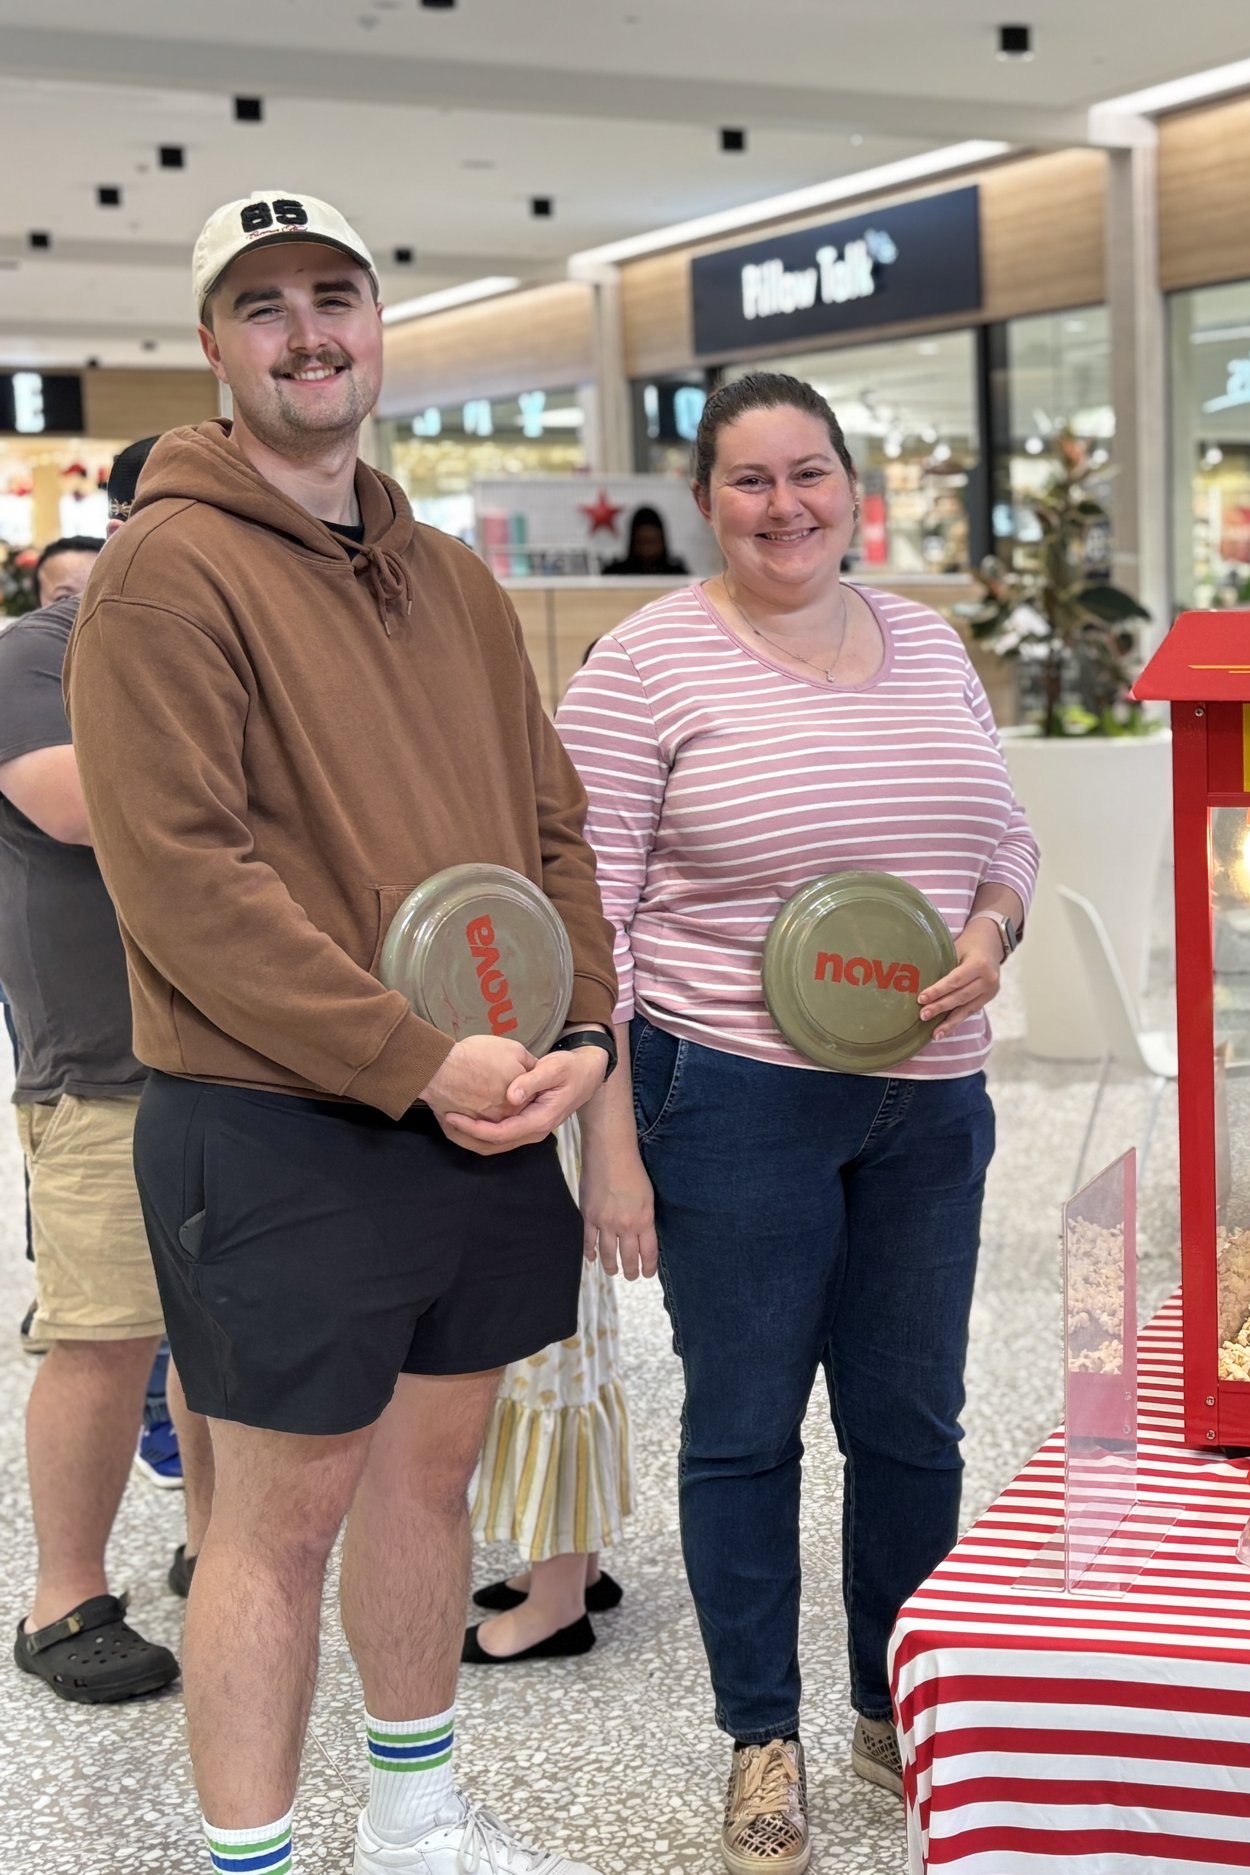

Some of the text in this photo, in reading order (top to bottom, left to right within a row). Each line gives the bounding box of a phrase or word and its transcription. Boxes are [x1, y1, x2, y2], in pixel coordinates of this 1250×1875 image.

[240, 199, 308, 233] 85
[741, 239, 875, 320] Pillow Talk
[466, 913, 518, 1036] nova
[815, 952, 920, 993] nova
